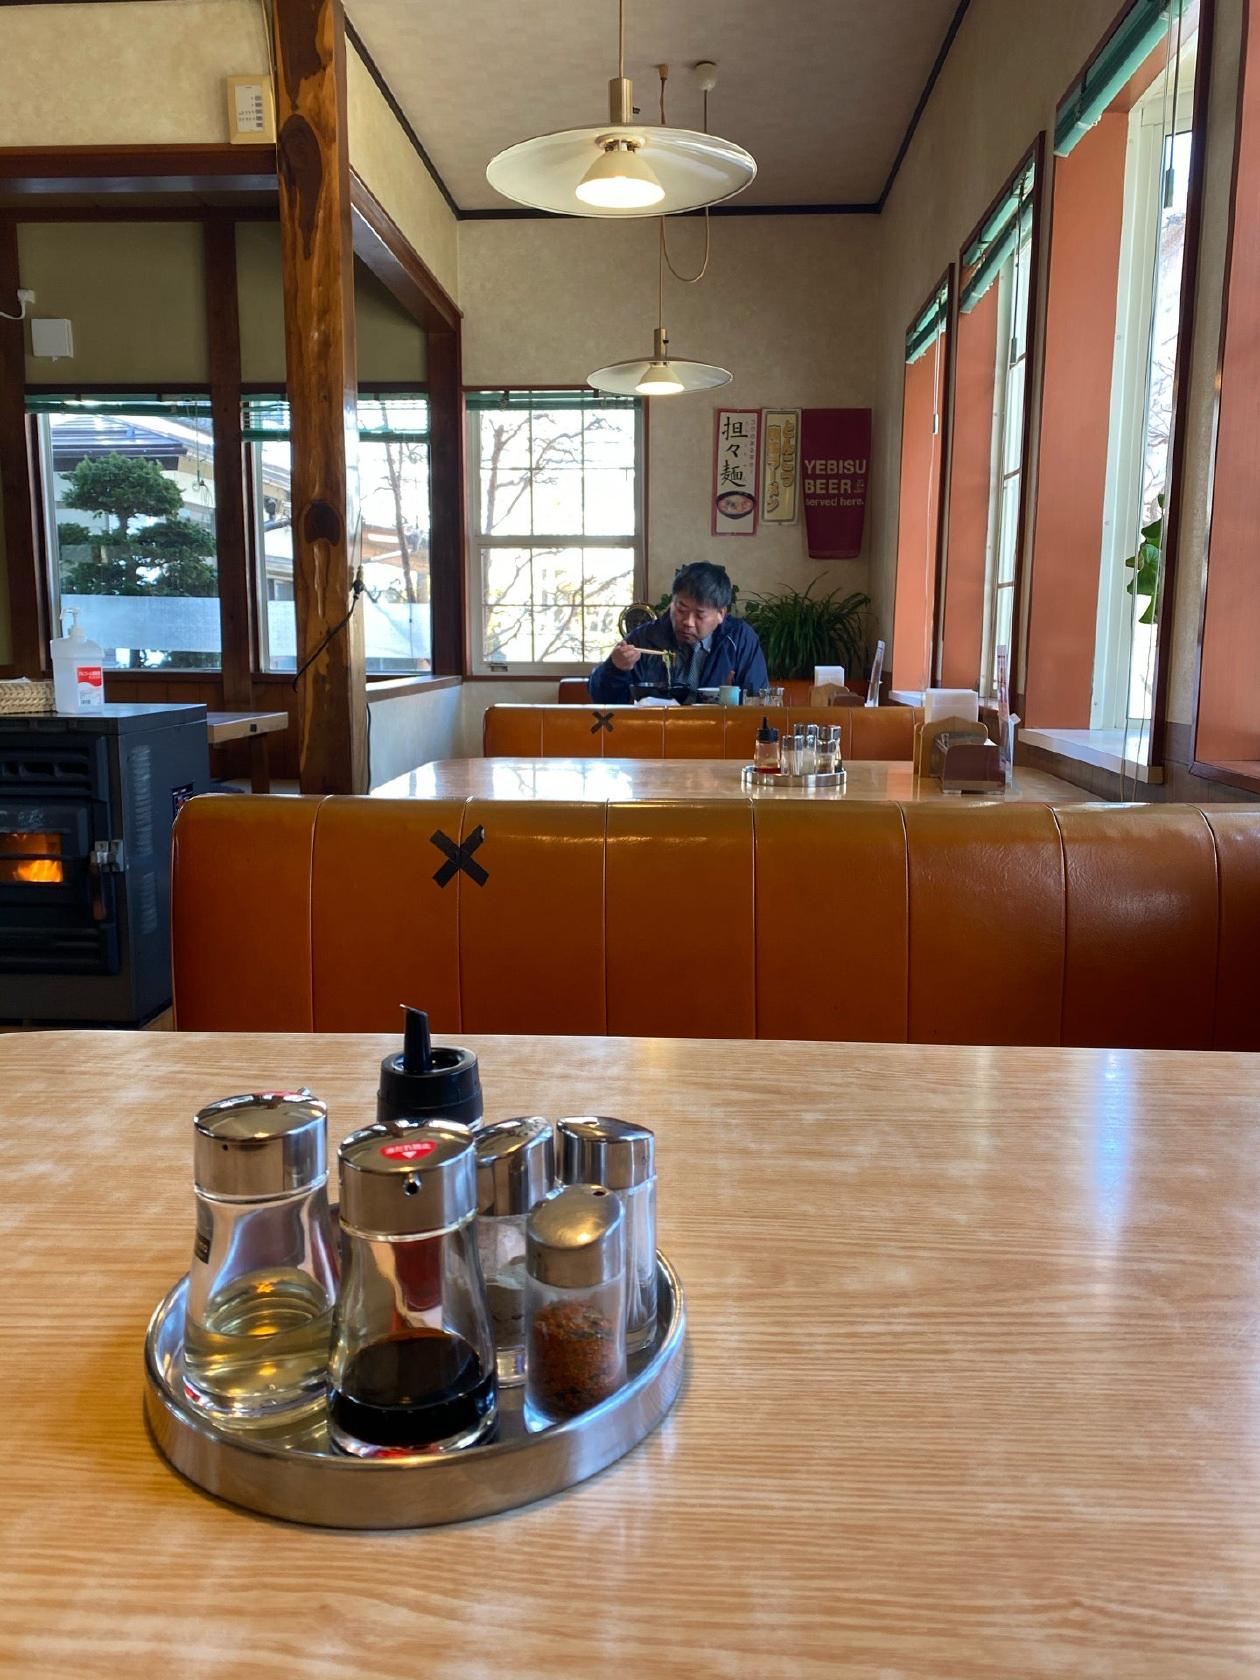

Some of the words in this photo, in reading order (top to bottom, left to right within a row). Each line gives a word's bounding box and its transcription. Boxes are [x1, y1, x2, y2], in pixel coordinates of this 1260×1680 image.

[804, 459, 866, 474] YEBISU
[804, 479, 852, 494] BEER
[805, 496, 838, 507] served
